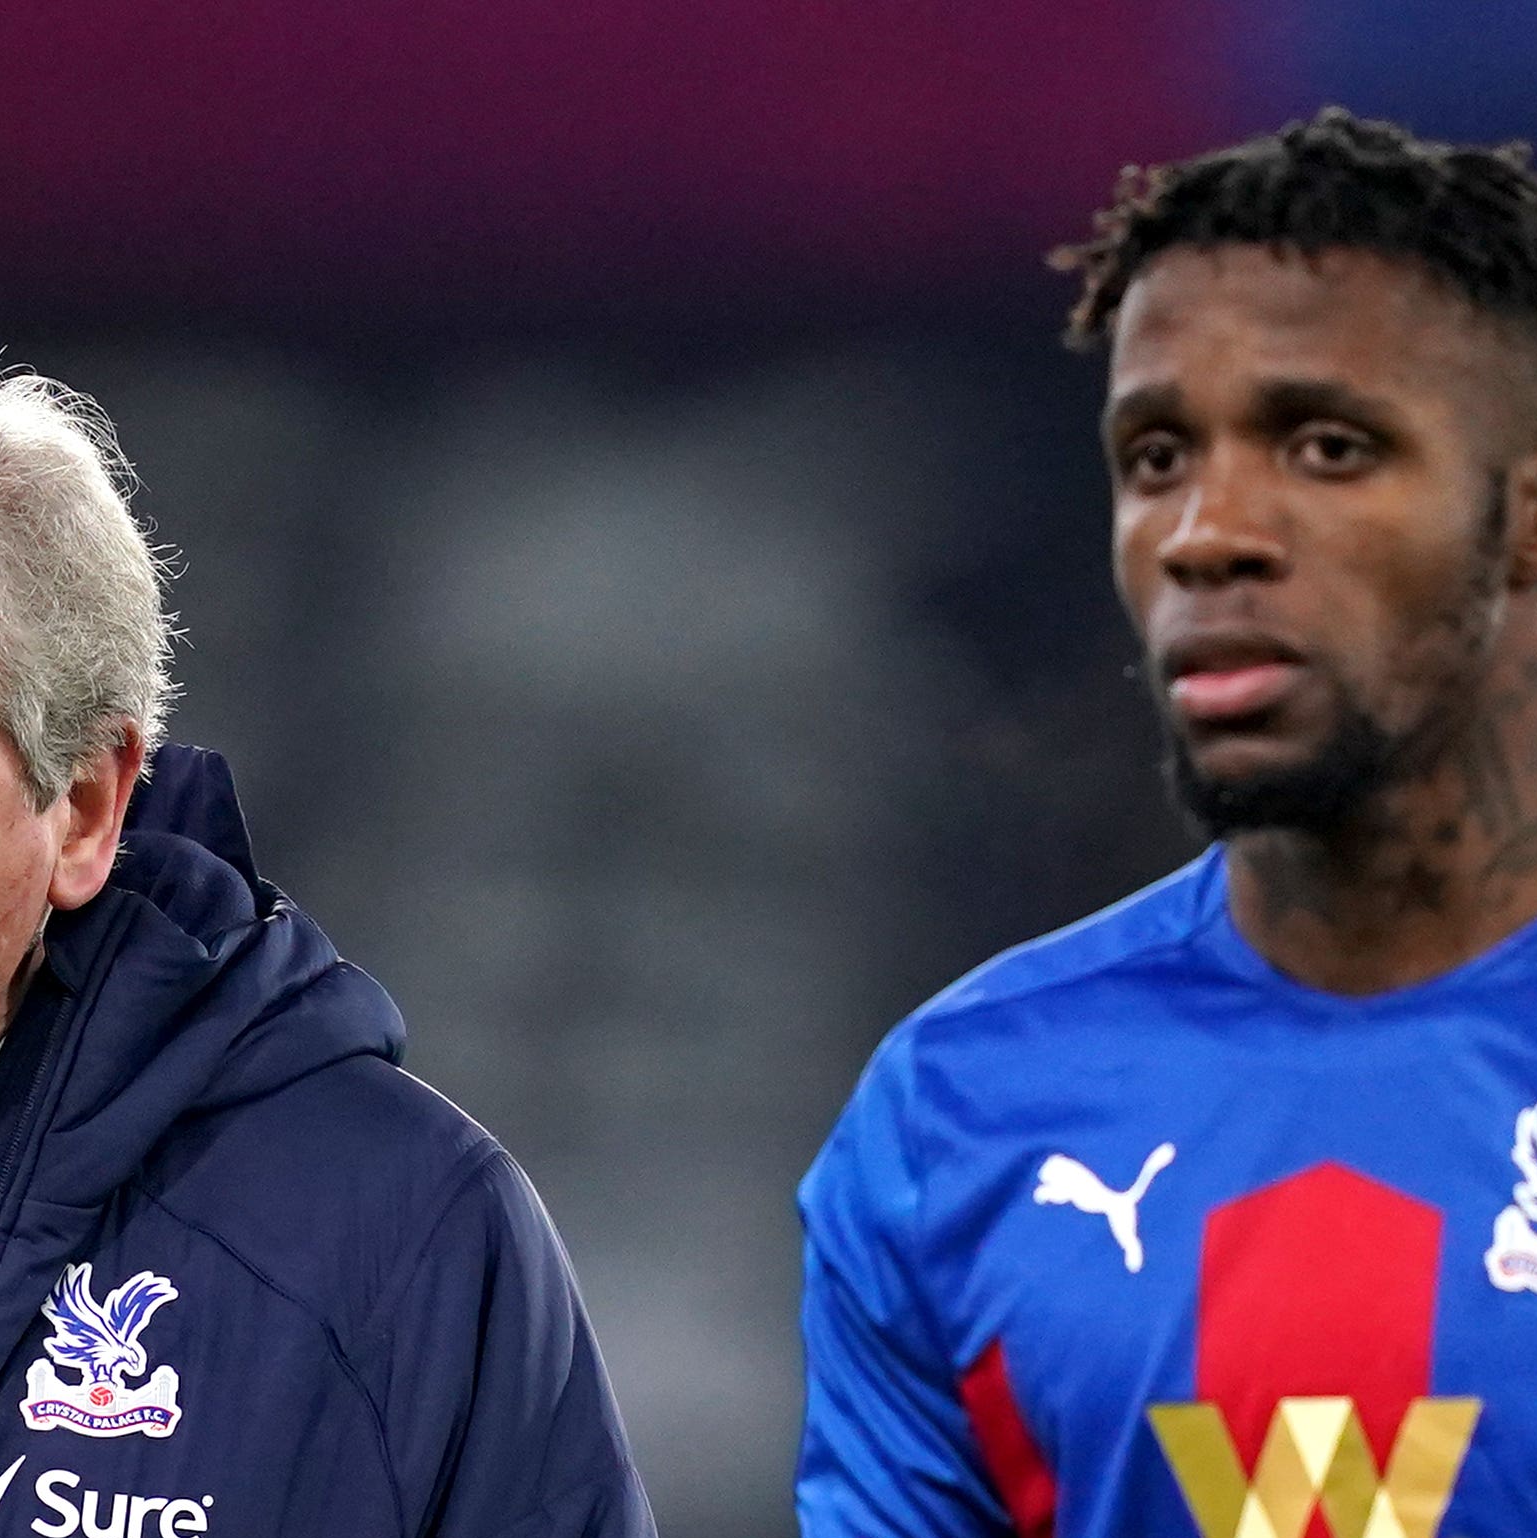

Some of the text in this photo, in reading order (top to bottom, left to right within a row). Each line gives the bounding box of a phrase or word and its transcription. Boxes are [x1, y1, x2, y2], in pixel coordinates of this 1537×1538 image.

[36, 1402, 165, 1429] CRYSTAL PALACE F.C.
